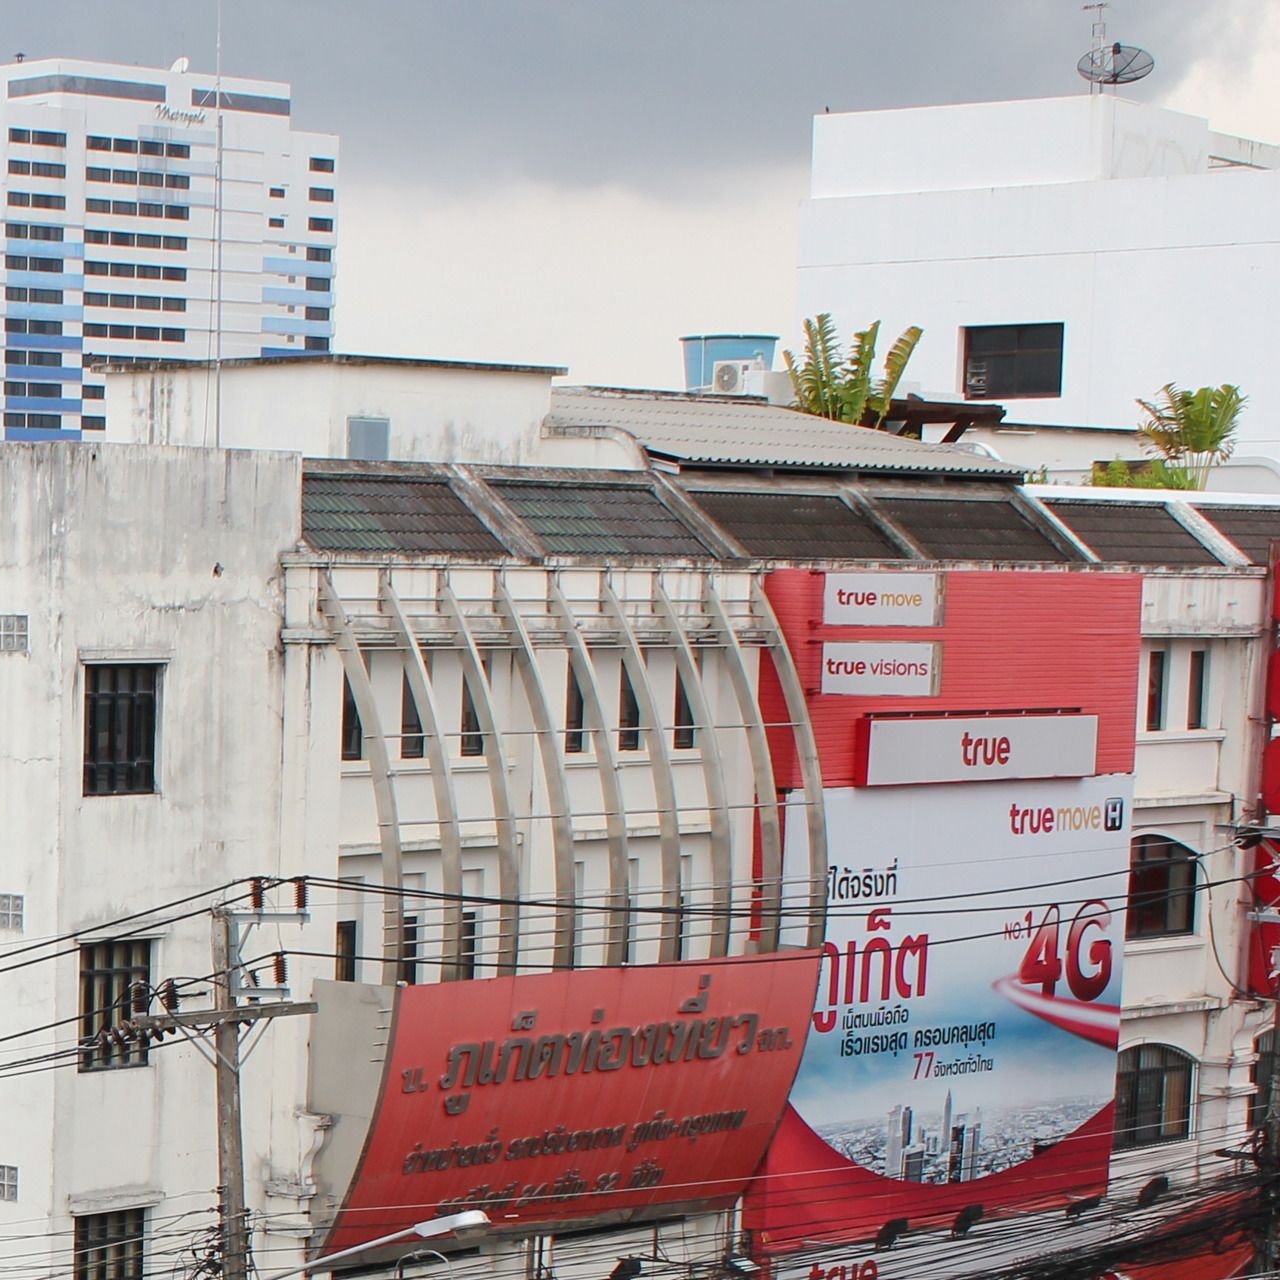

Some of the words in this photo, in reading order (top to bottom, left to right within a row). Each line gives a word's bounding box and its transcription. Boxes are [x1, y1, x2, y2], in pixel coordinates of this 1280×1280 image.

[837, 588, 877, 606] true
[880, 592, 922, 607] move
[826, 658, 866, 676] true
[870, 657, 928, 677] visions
[961, 731, 1010, 767] true
[1019, 899, 1113, 1001] 4G
[842, 1006, 909, 1030] เน็ตบนมือถือ
[440, 974, 759, 1116] ภูเก็ตท่องเที่ยว
[840, 1031, 908, 1056] เร็วแรงสุด
[914, 1021, 996, 1049] ครอบคลุมสุด
[913, 1051, 935, 1080] 77
[934, 1053, 994, 1078] จังหวัดทั่วไทย
